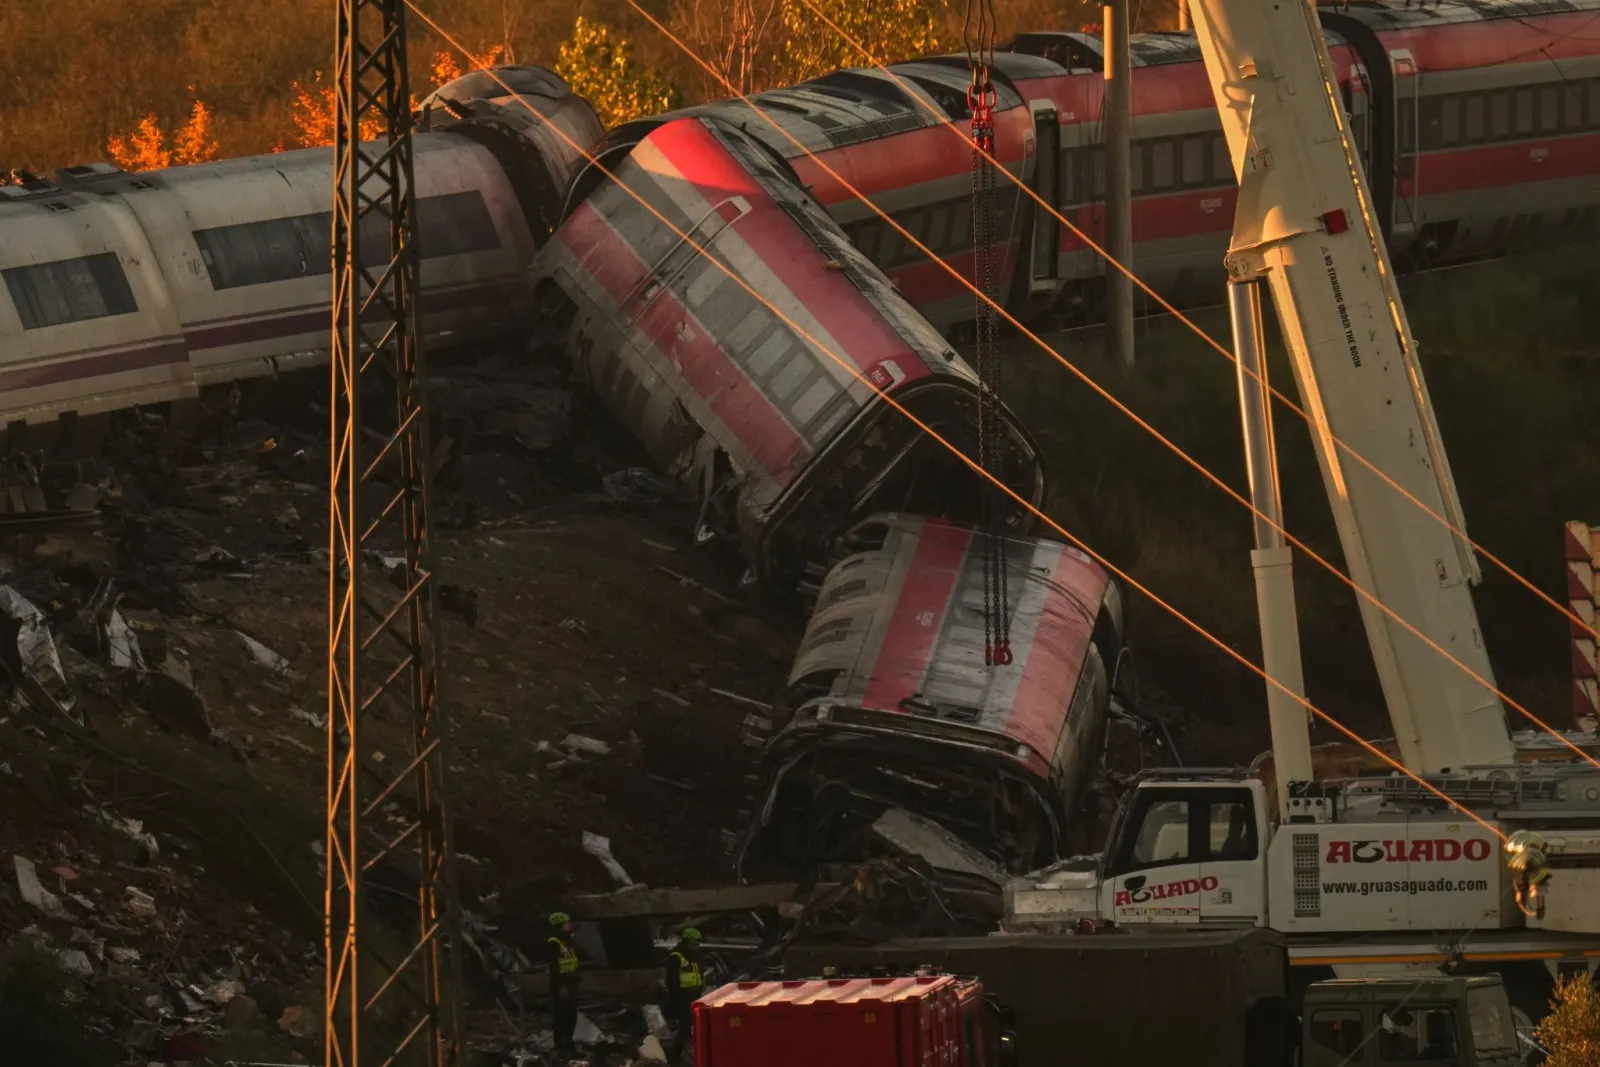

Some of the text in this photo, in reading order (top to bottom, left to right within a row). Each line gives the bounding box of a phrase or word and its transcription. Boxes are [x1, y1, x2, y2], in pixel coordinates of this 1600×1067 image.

[1324, 255, 1362, 368] NO STANDING UNDER THE BOOM
[1326, 838, 1491, 863] AGUADO
[1115, 876, 1218, 906] AGUADO
[1322, 878, 1488, 895] www.gruasaguado.com
